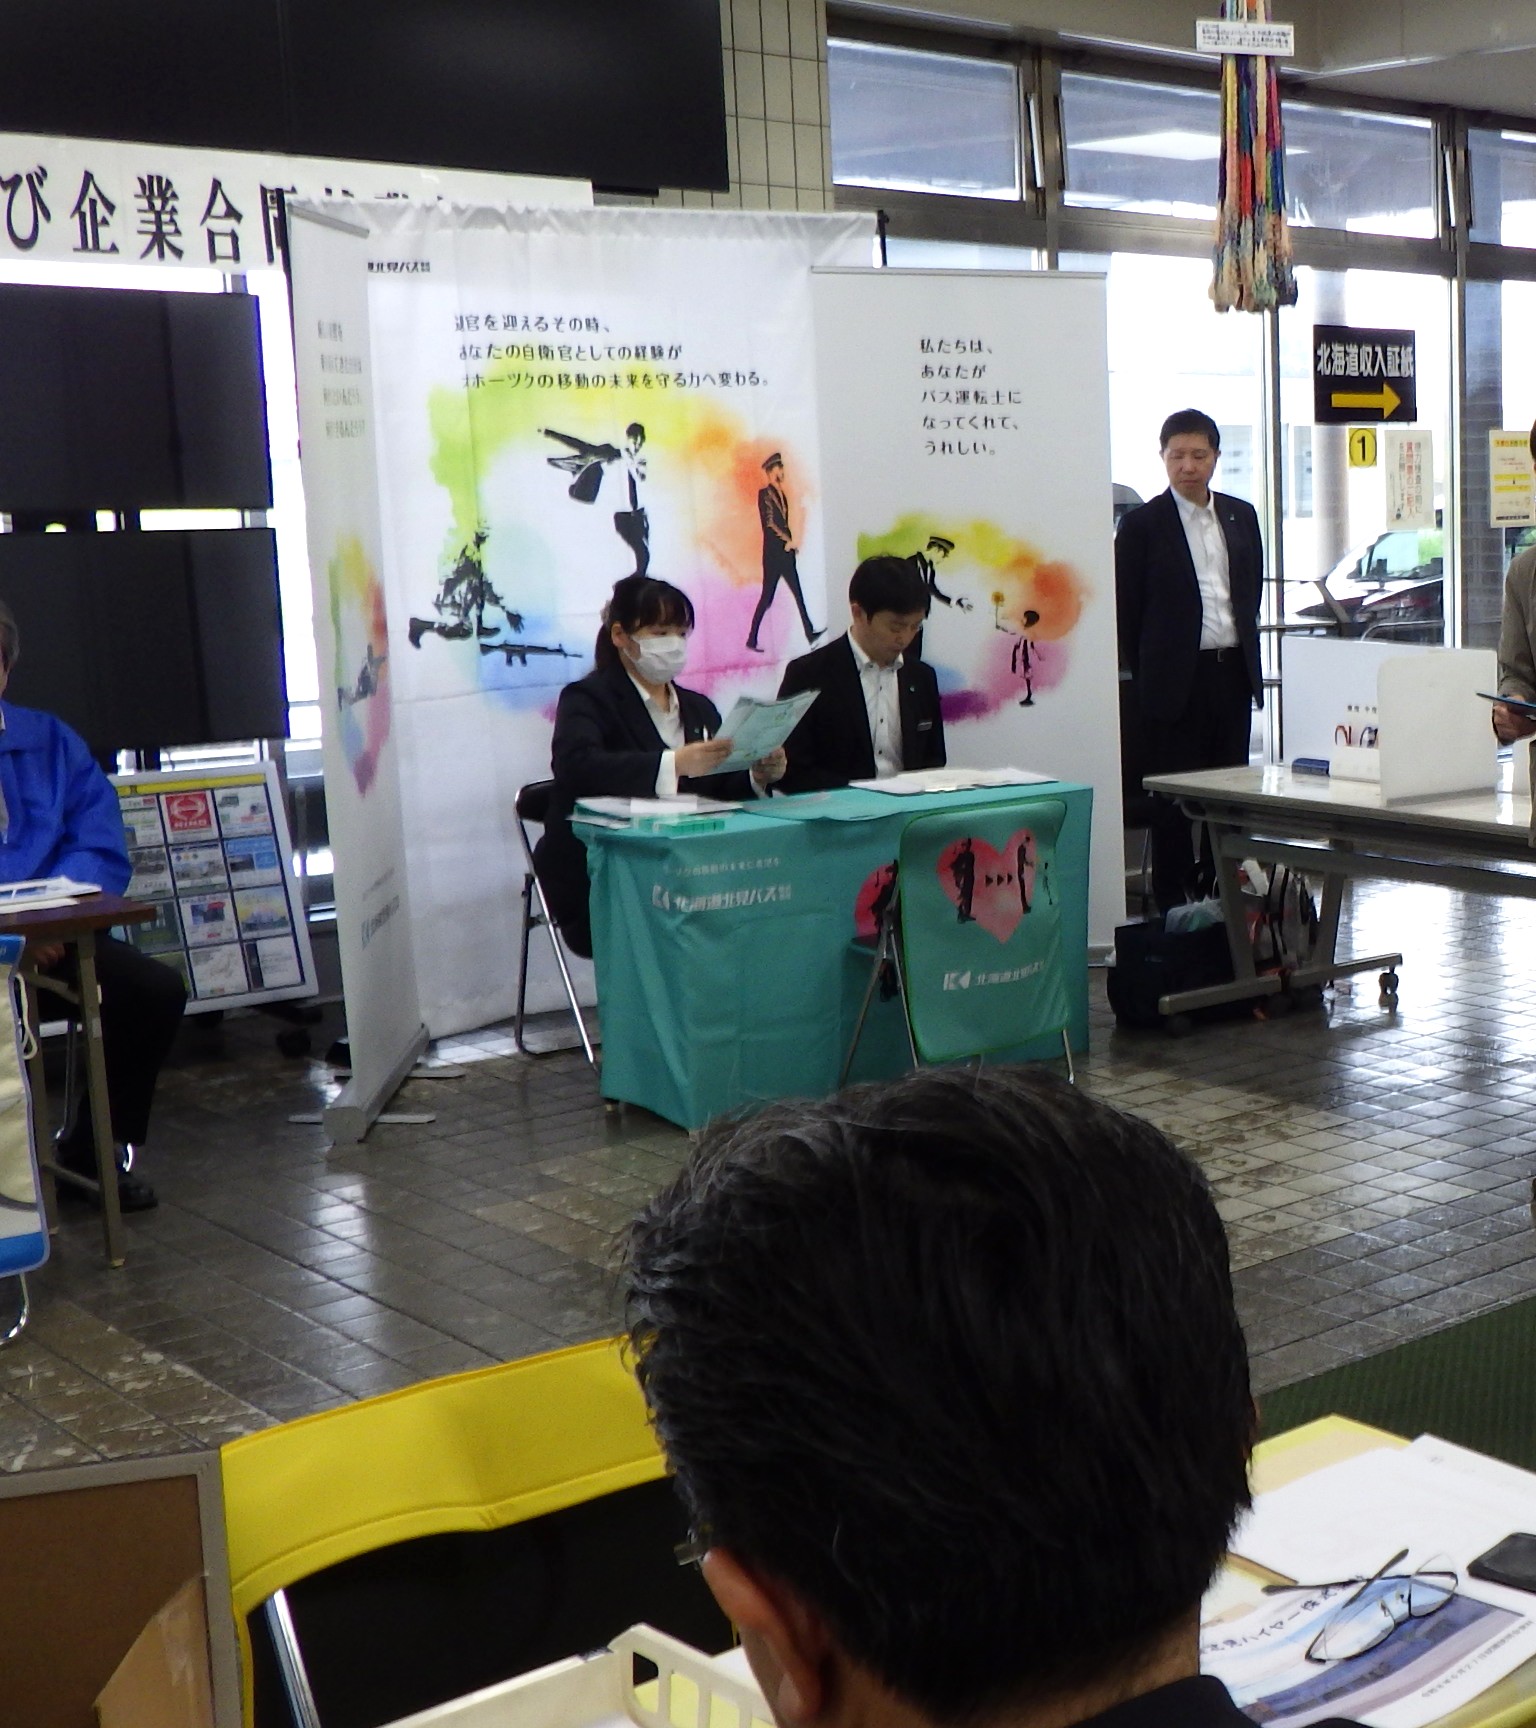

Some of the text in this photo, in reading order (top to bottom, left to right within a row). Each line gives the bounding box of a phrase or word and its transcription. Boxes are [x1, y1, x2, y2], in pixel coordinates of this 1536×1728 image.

[920, 338, 993, 354] 私たちは、
[1316, 341, 1414, 377] 北海道収入証紙
[921, 364, 986, 379] あなたが
[922, 390, 1022, 405] バス運転士に
[922, 415, 1019, 430] なってくれて、
[924, 440, 996, 456] うれしい。
